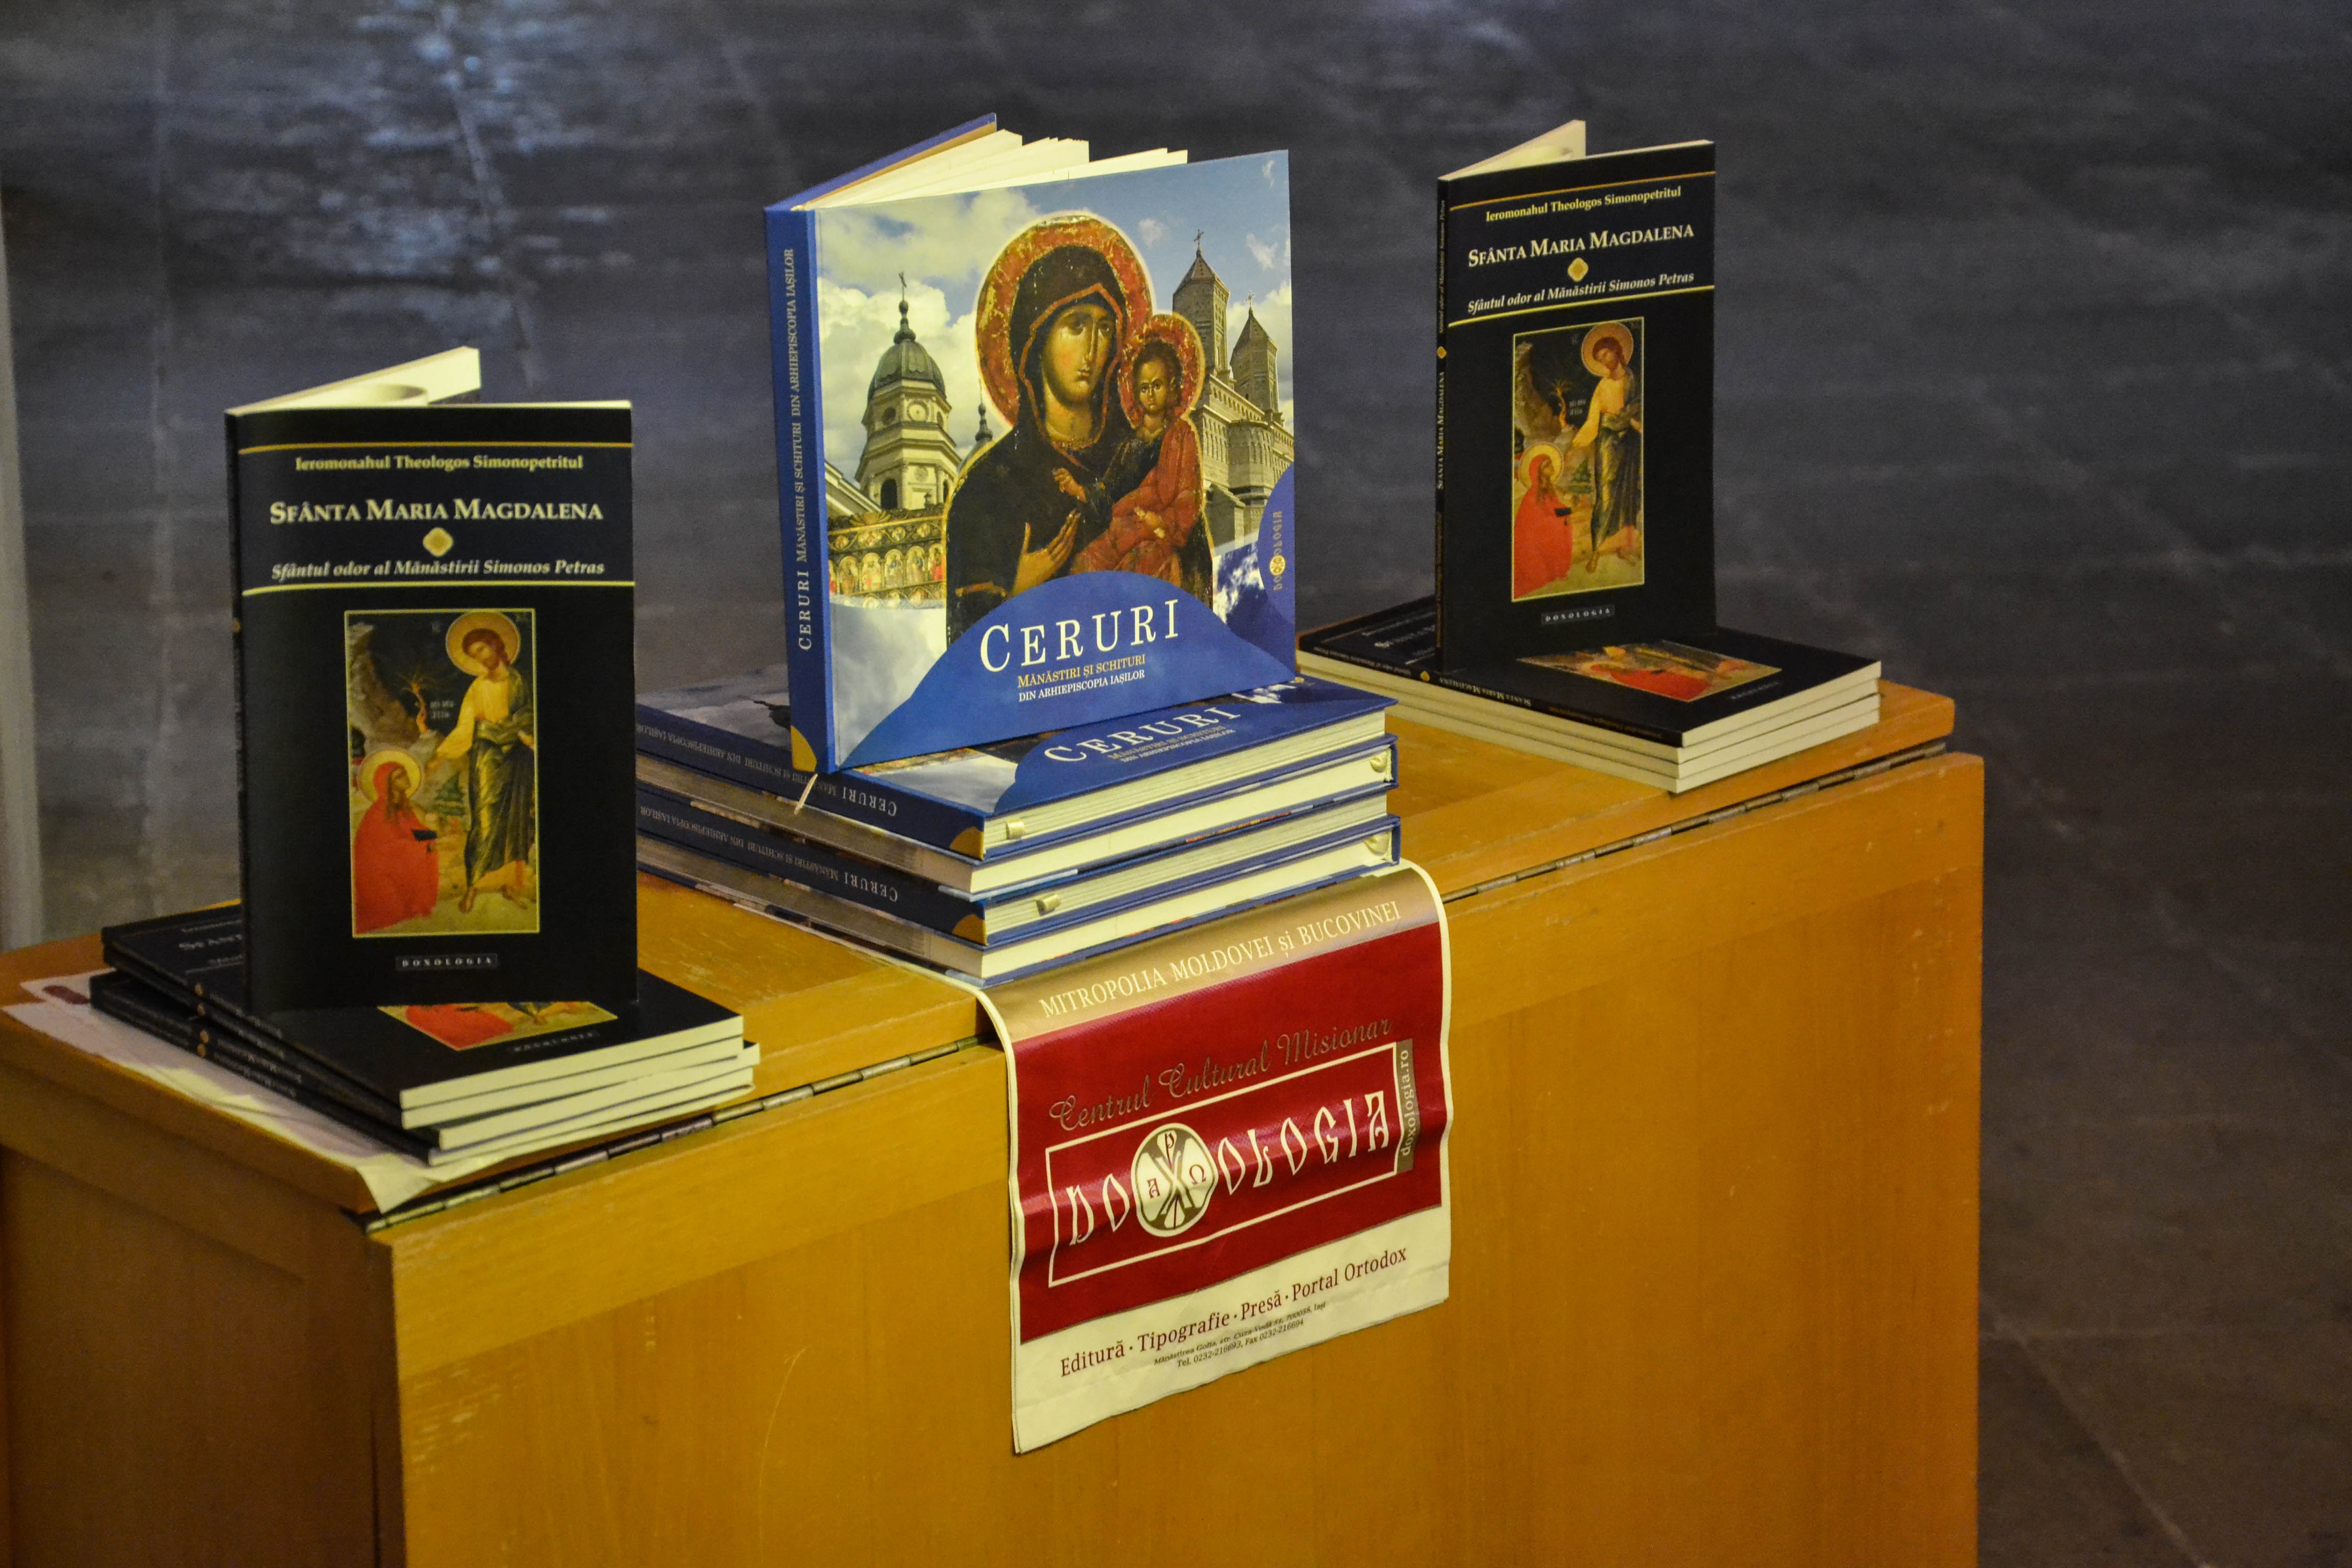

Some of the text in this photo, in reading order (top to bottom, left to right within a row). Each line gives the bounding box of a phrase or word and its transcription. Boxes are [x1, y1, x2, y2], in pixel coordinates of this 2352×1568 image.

[1486, 185, 1681, 222] Ieromonahul Theologos Simonopetritul
[1468, 224, 1694, 267] SFÂNTA MARIA MAGDALENA
[783, 249, 797, 297] IAȘILOR
[1467, 273, 1694, 315] Sfântul odor al Mănăstirii Simonos Petras
[786, 299, 800, 393] ARHIEPISCOPIA
[790, 394, 801, 416] DIN
[295, 454, 584, 472] Ieromonahul Theologos Simonopetritul
[792, 422, 803, 479] SCHITURI
[794, 481, 806, 493] ȘI
[270, 498, 604, 525] SFÂNTA MARIA MAGDALENA
[271, 559, 605, 583] Sfântul odor al Mănăstirii Simonos Petras
[797, 571, 812, 651] CERURI
[980, 599, 1179, 672] CERURI
[1017, 653, 1145, 689] MĂNĂSTIRI ȘI SCHITURI
[1018, 669, 1145, 702] DIN ARHIEPISCOPIA IAȘILOR
[1044, 706, 1241, 763] CERURI
[841, 785, 897, 818] CERURI
[843, 871, 897, 902] CERURI
[1039, 968, 1168, 1018] MITROPOLIA
[1169, 936, 1275, 982] MOLDOVEI
[1297, 900, 1402, 946] BUCOVINEI
[1049, 1019, 1392, 1132] Centrul Cultural Misionar
[1400, 1049, 1417, 1157] doxologia.ro
[1061, 1248, 1406, 1377] Editură Tipografie Presă Portal Ortodox
[1193, 1339, 1243, 1363] 0232-216693,
[1244, 1336, 1258, 1346] Fax
[1259, 1319, 1304, 1341] 0232-216694
